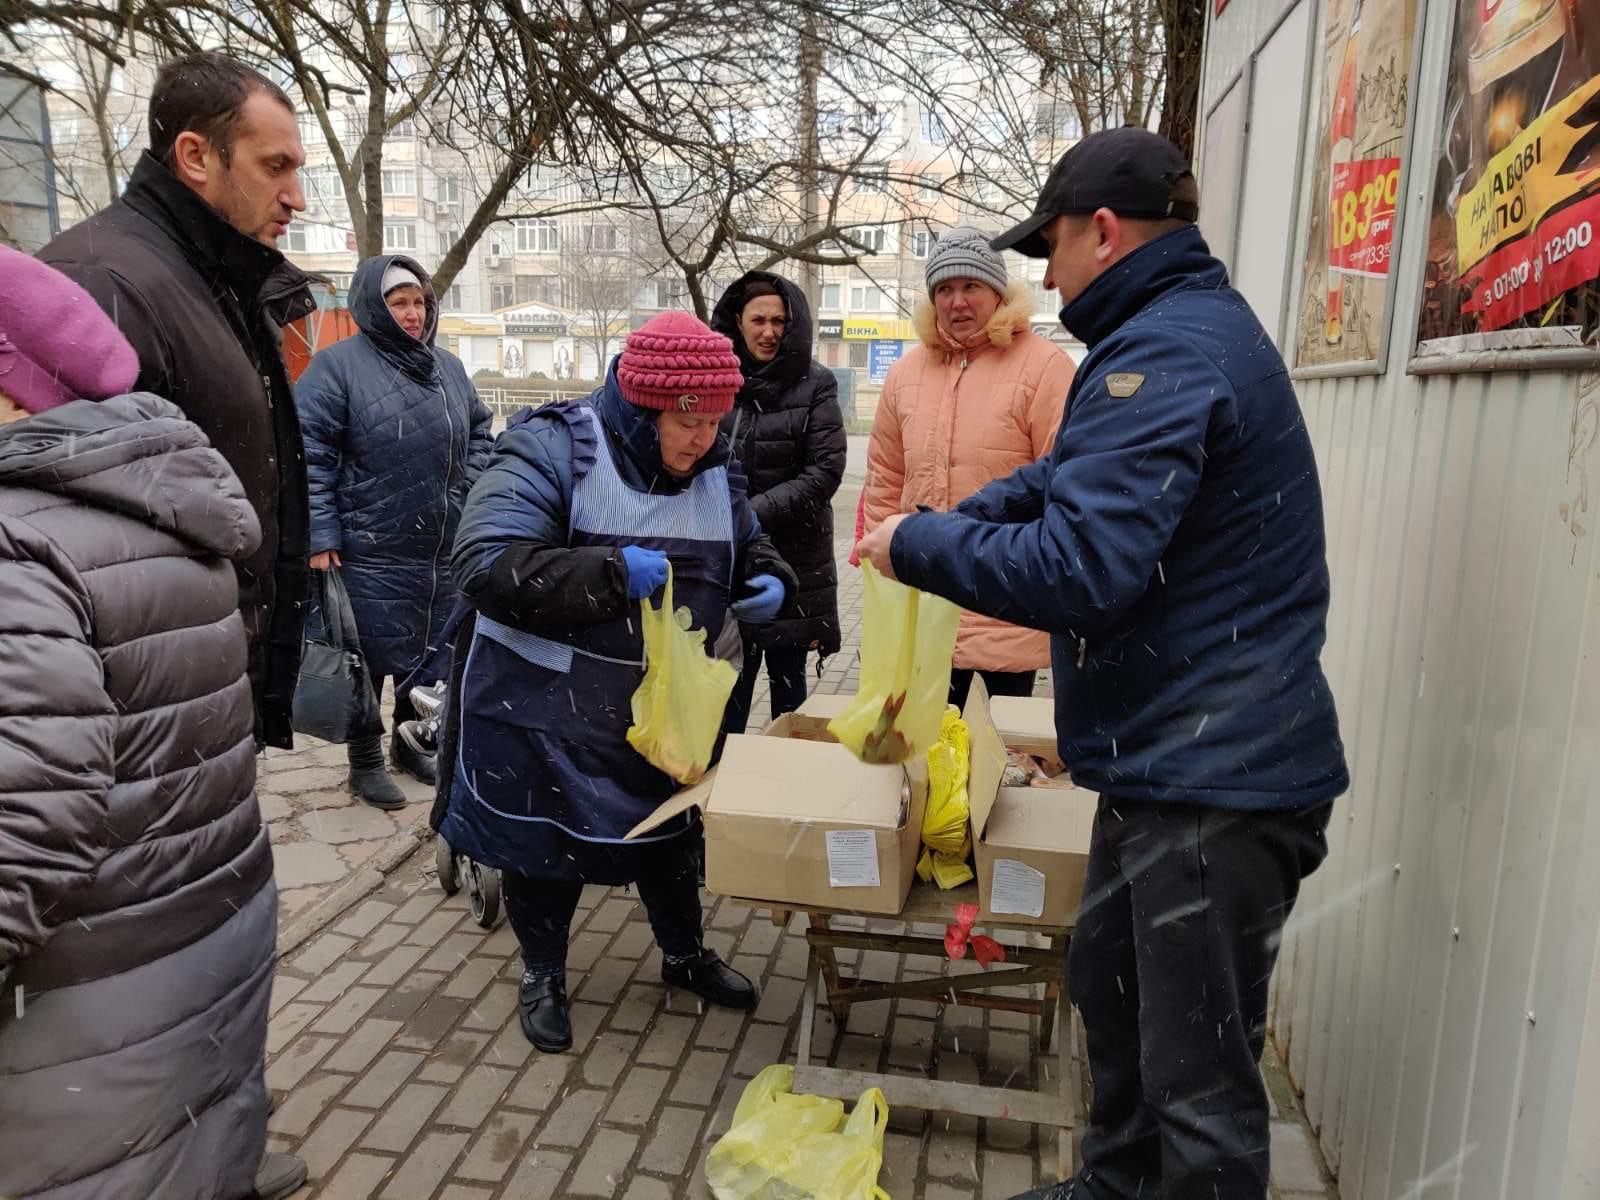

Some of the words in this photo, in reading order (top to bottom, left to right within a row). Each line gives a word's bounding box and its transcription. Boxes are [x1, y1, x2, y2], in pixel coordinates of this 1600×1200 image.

[1371, 218, 1390, 237] грн
[1494, 260, 1529, 300] 07:00
[1544, 221, 1592, 265] 12:00
[847, 327, 878, 336] ВІКНА
